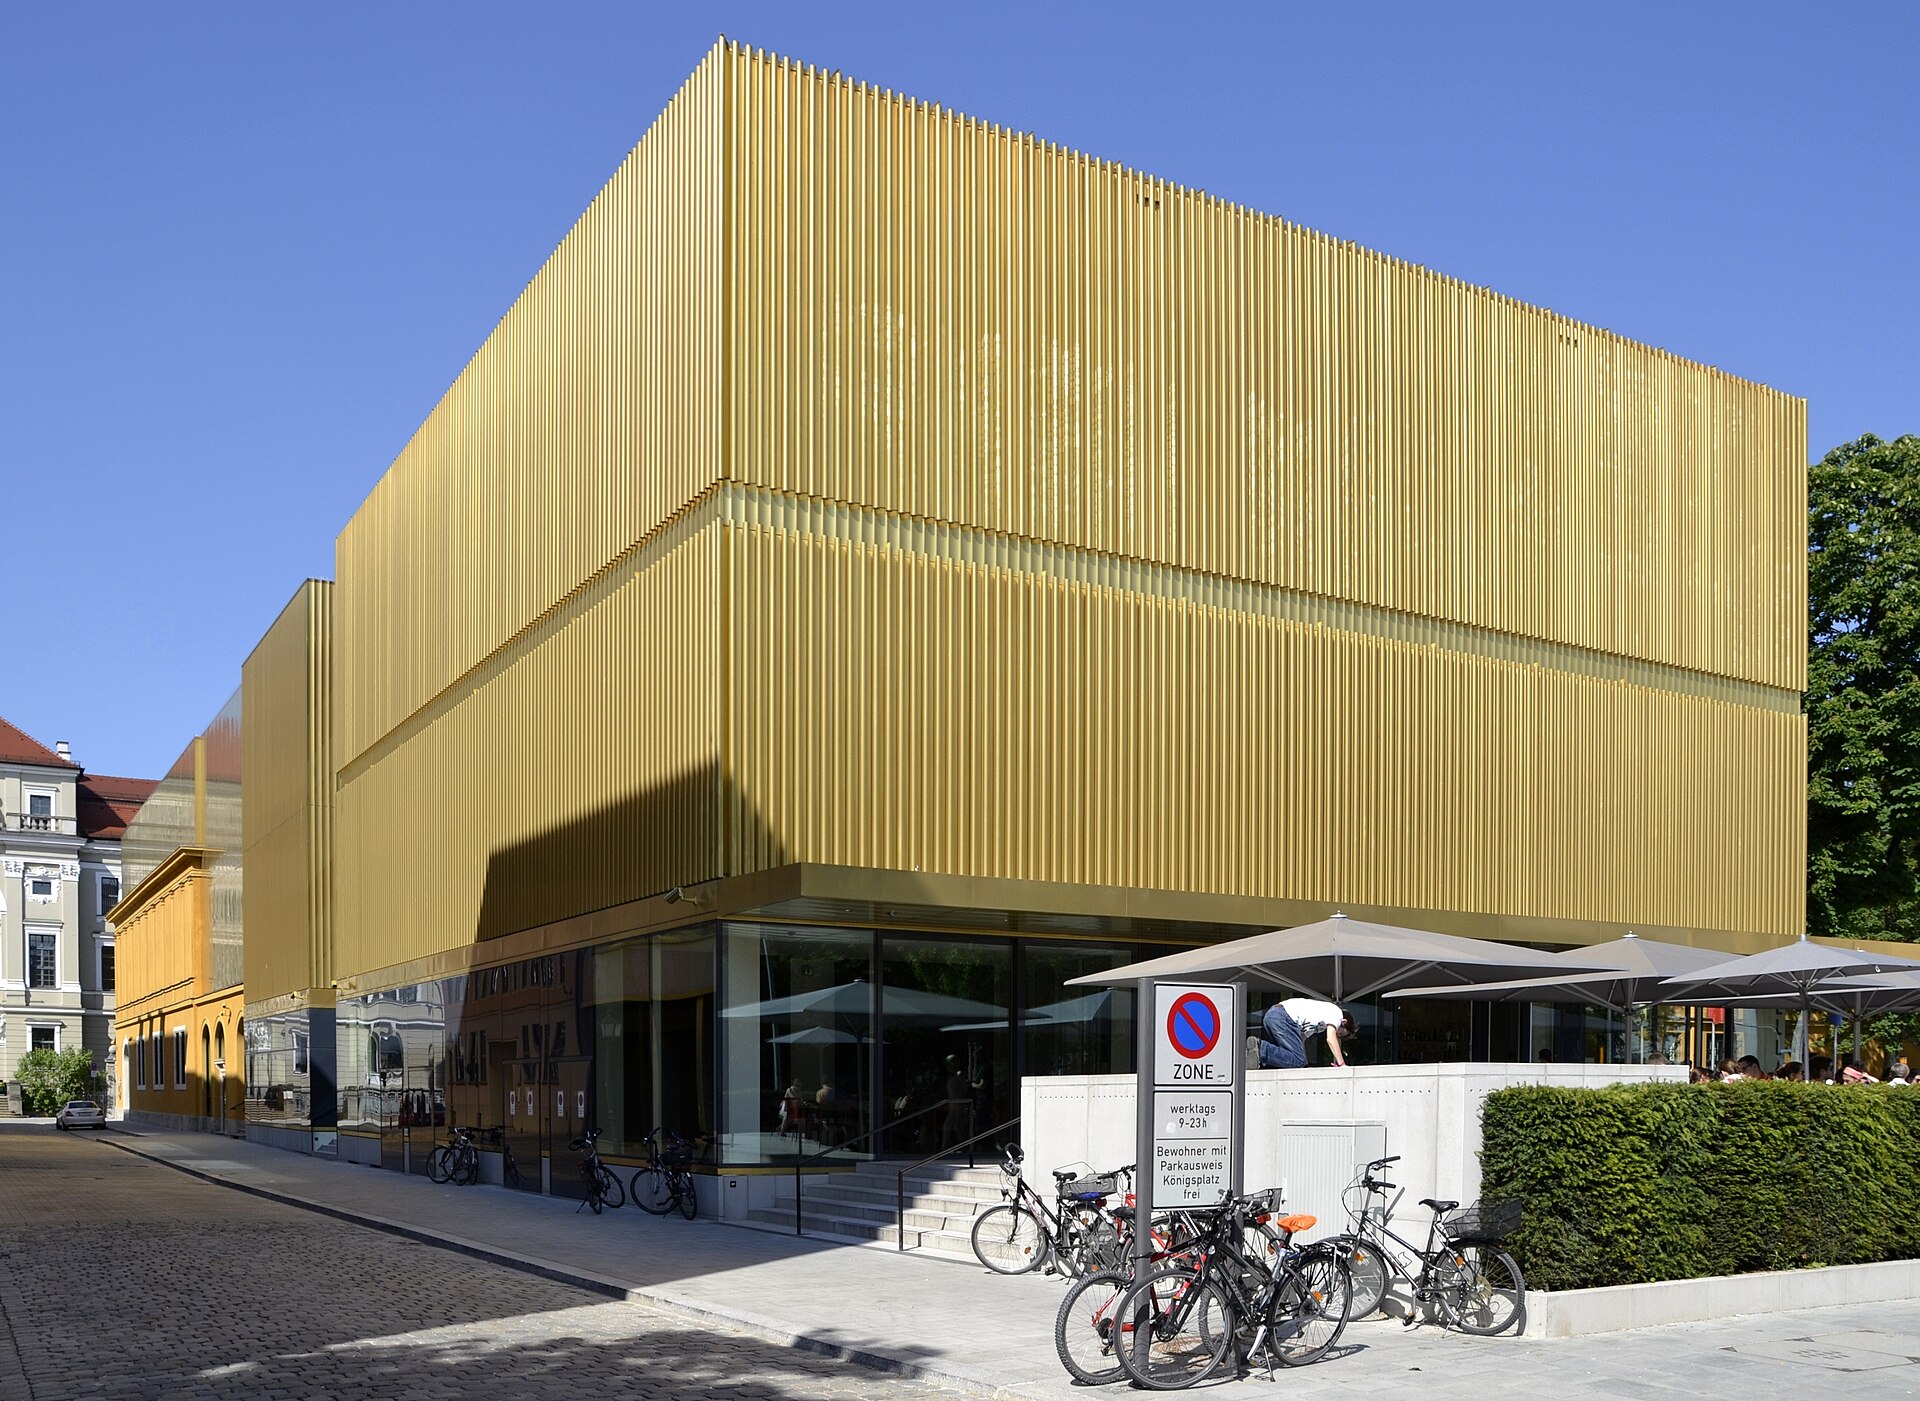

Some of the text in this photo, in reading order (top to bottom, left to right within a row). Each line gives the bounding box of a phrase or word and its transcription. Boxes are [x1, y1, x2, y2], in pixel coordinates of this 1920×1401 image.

[1173, 1064, 1213, 1079] ZONE
[1170, 1103, 1216, 1116] werktags
[1157, 1145, 1227, 1157] Bewohner mit
[1160, 1160, 1223, 1171] Parkausweis
[1163, 1175, 1220, 1187] Königsplatz
[1183, 1189, 1200, 1199] frei
